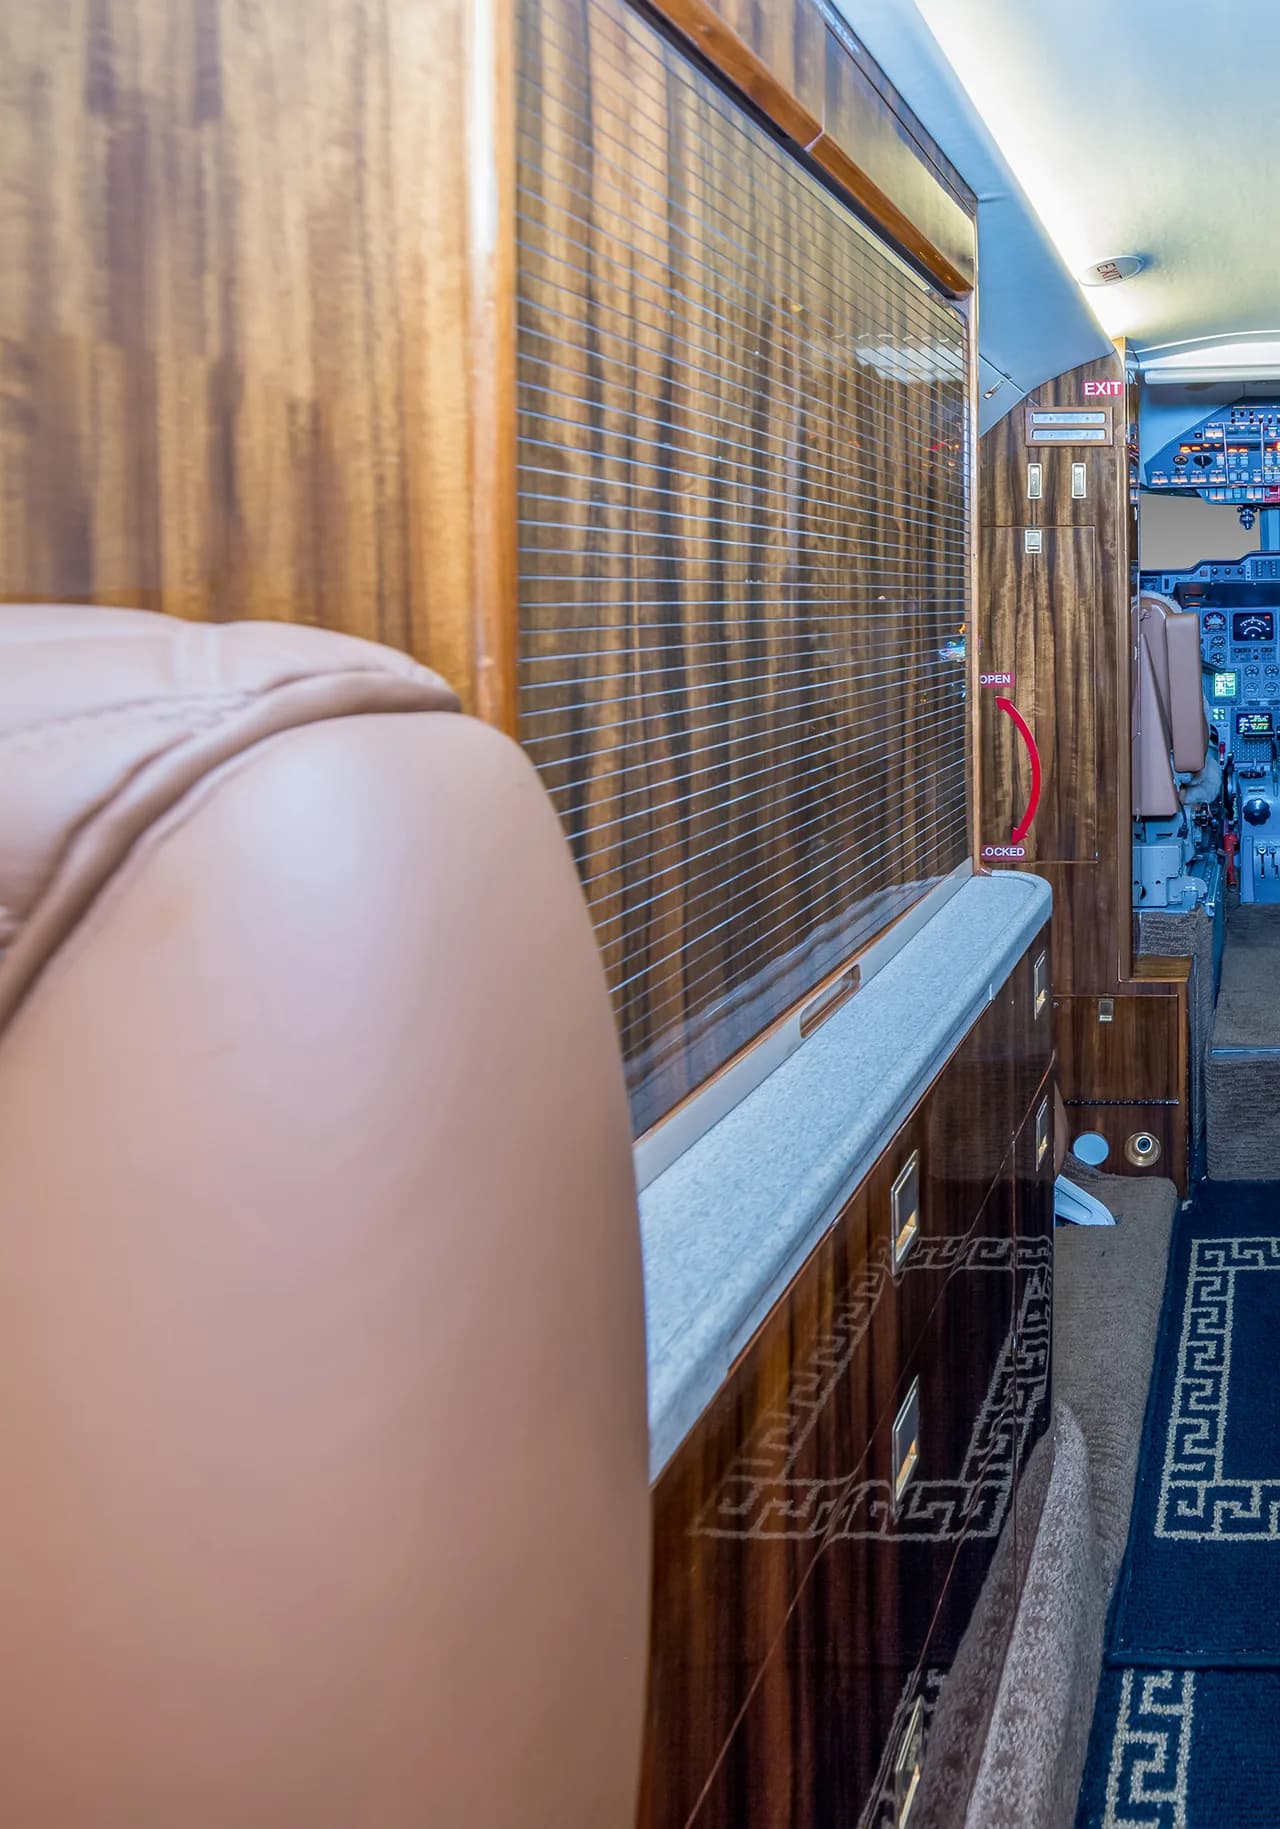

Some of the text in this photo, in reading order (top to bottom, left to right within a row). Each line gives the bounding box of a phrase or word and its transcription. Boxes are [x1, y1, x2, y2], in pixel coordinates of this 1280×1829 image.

[1097, 262, 1123, 282] EXIT
[1084, 381, 1121, 395] EXIT
[980, 674, 1011, 684] OPEN
[981, 846, 1025, 856] OCKED
